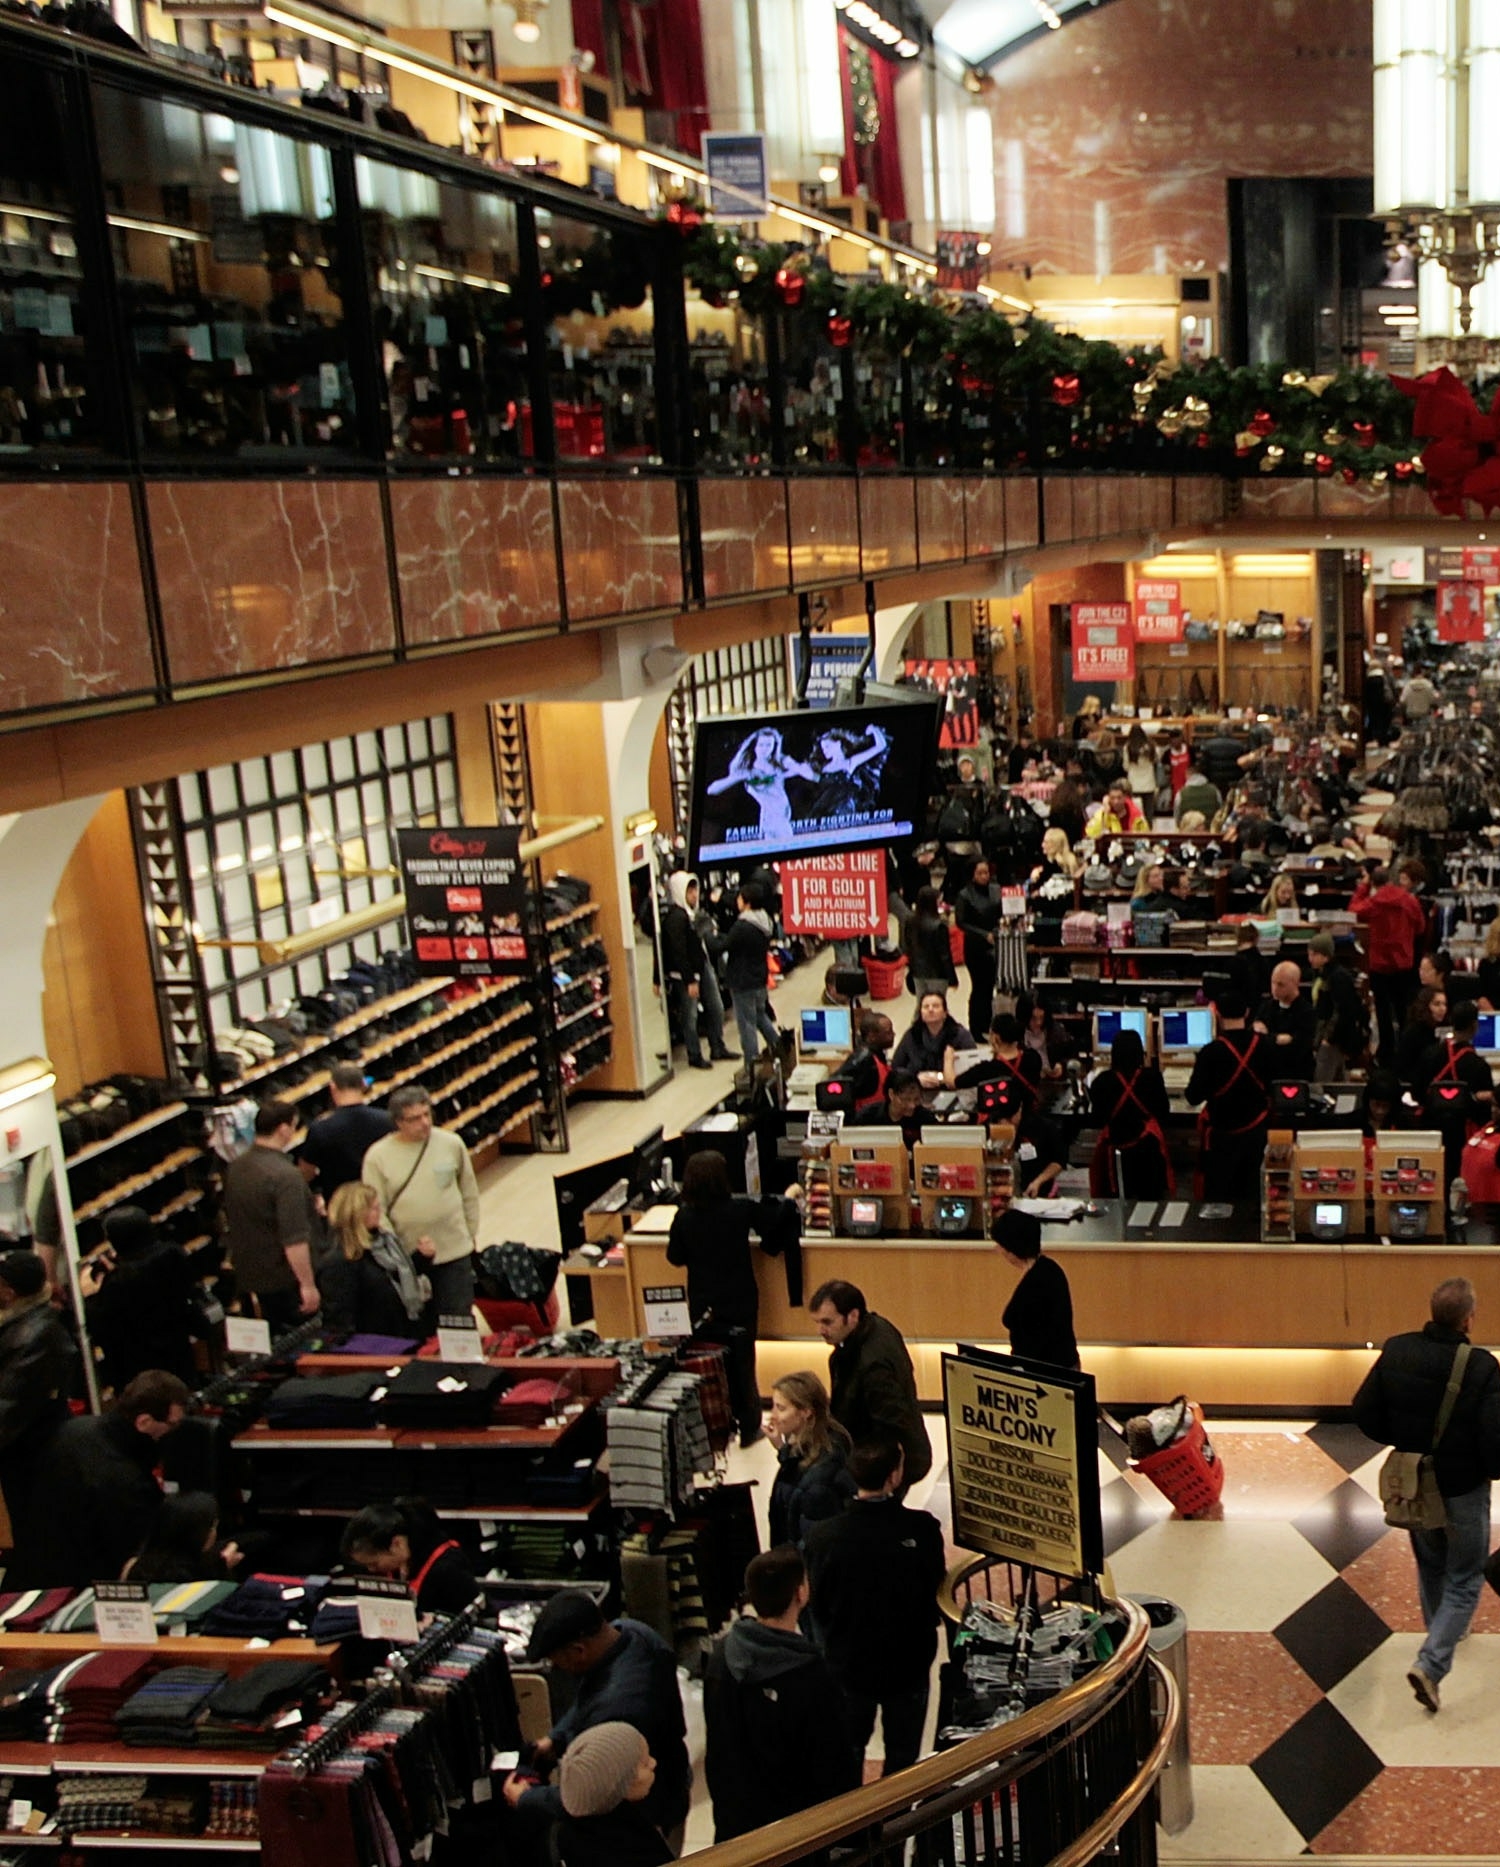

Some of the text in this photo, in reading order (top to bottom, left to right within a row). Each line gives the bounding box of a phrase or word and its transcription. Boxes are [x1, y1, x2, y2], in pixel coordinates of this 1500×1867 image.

[821, 810, 869, 826] FIGHTING
[873, 808, 893, 819] FOR
[850, 854, 878, 872] LINE
[803, 877, 865, 896] FOR GOLD
[804, 898, 866, 910] AND PLATINUM
[804, 911, 867, 929] MEMBERS
[977, 1385, 1038, 1419] MEN'S
[962, 1405, 1057, 1448] BALCONY
[968, 1453, 1005, 1474] DOLCE
[1016, 1466, 1070, 1490] GABBANA
[961, 1468, 1070, 1508] VERSACE COLLECTION
[965, 1487, 1076, 1527] JEAN PAUL GAULTIER
